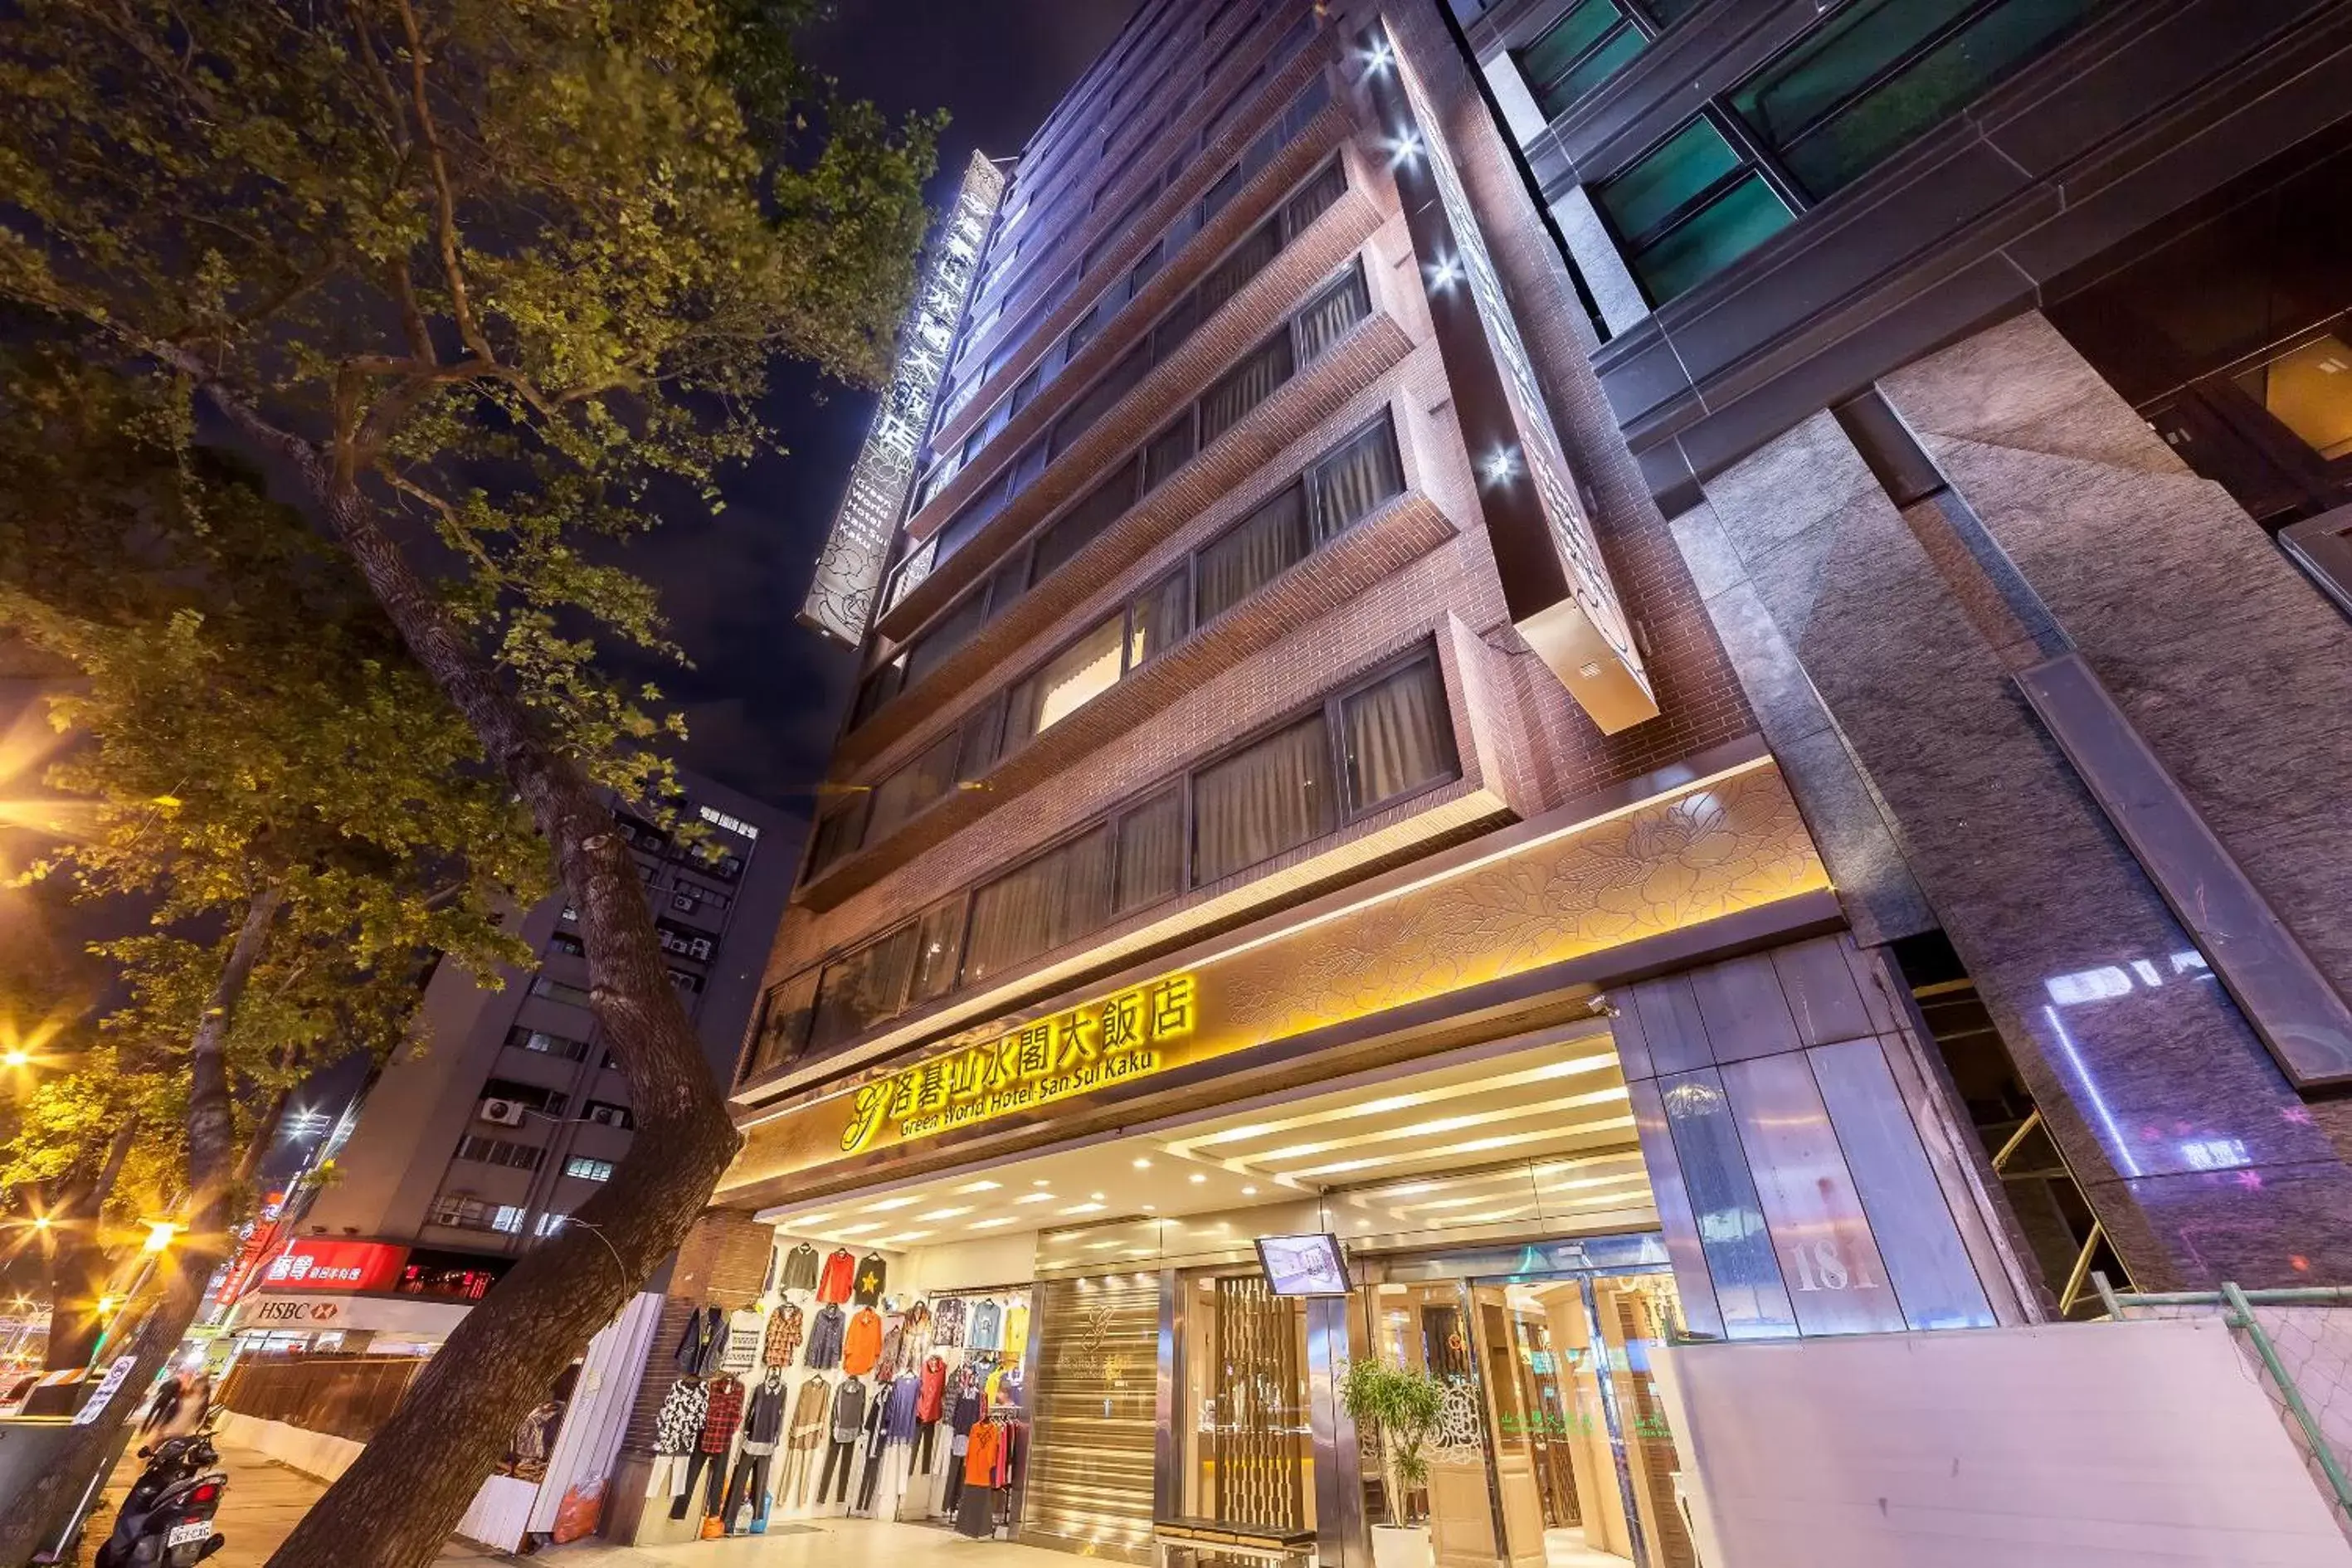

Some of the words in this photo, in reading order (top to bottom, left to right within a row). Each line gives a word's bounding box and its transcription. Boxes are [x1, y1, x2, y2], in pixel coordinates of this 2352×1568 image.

[852, 487, 889, 519] World
[855, 478, 892, 509] Green
[843, 511, 867, 532] San
[869, 528, 889, 547] Sui
[847, 499, 882, 528] Hotel
[840, 523, 871, 549] Kaku
[889, 979, 1190, 1118] 洛碁山水閣大飯店
[901, 1114, 937, 1137] Green
[945, 1098, 985, 1124] World
[991, 1080, 1033, 1113] Hotel
[1039, 1074, 1069, 1099] San
[1073, 1062, 1101, 1089] Sui
[1104, 1050, 1152, 1079] Kaku
[1790, 1239, 1879, 1291] 181
[257, 1303, 309, 1320] HSBC
